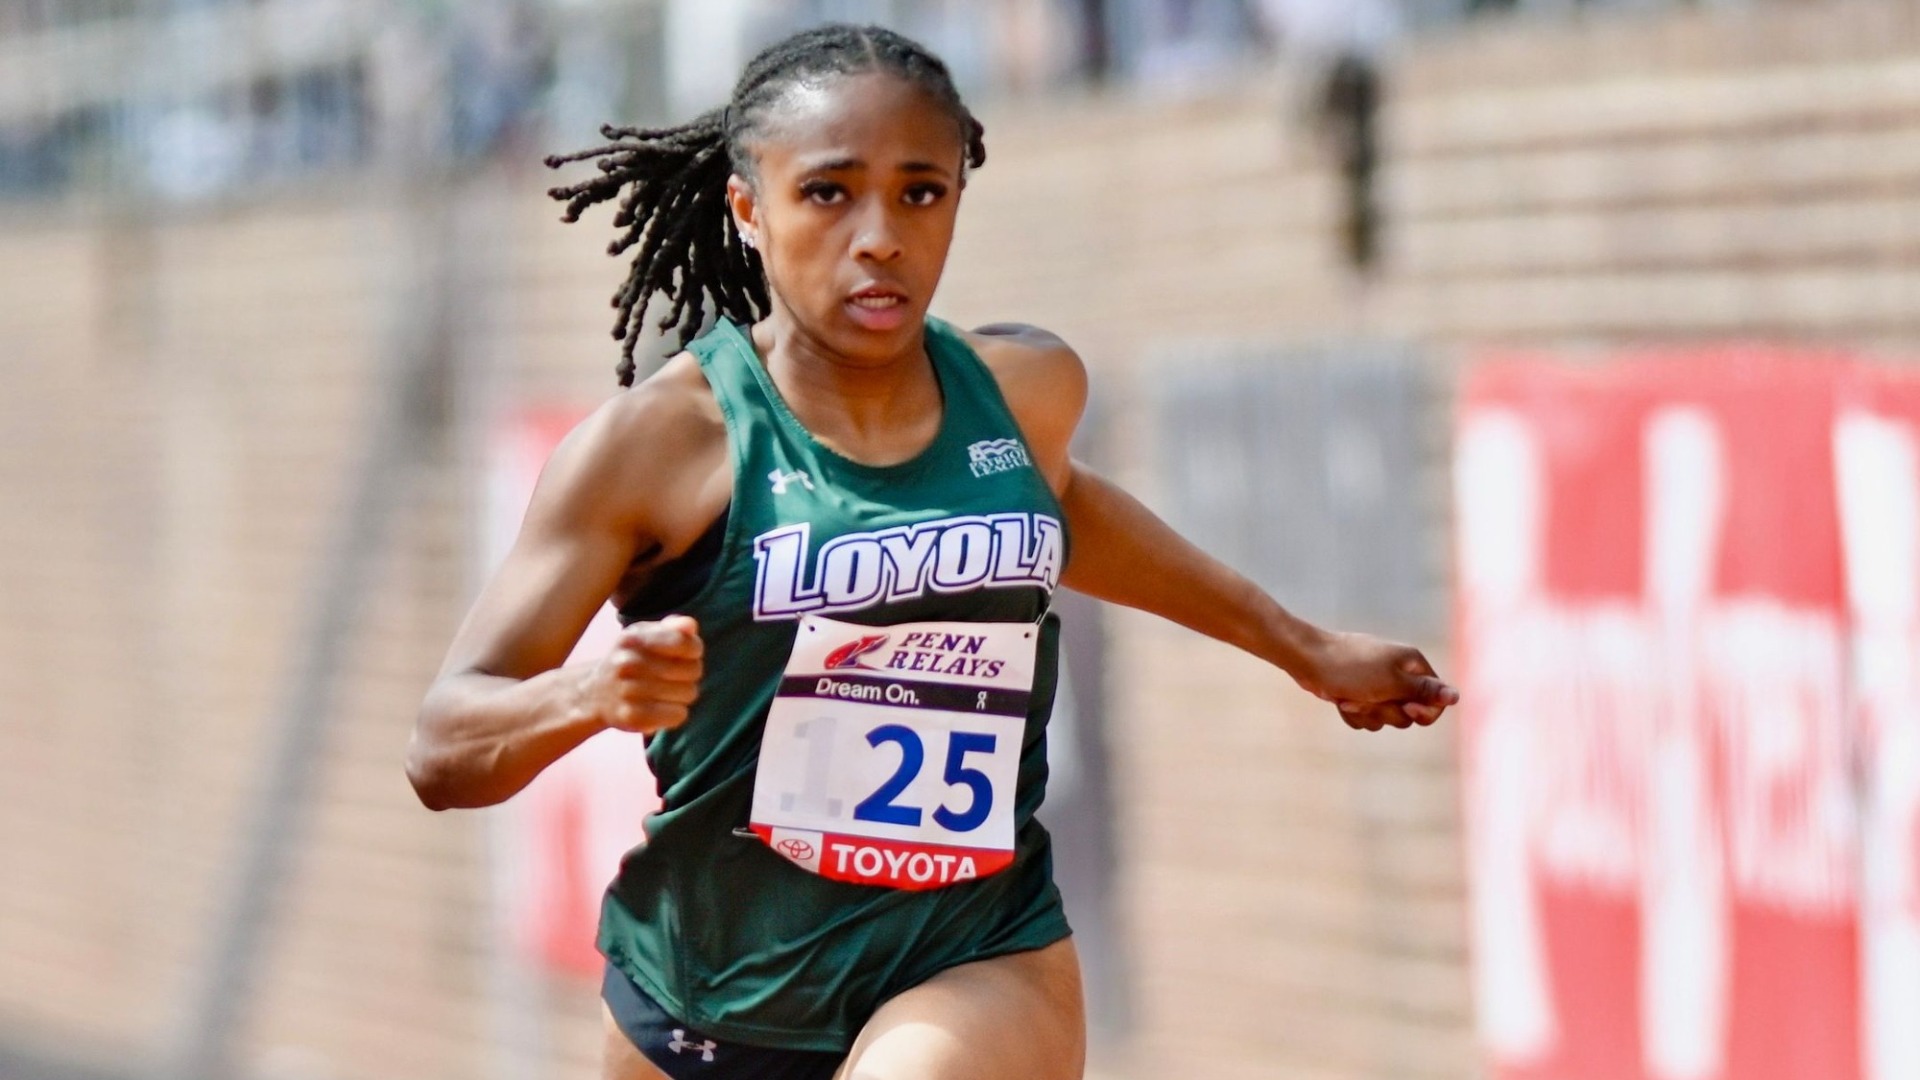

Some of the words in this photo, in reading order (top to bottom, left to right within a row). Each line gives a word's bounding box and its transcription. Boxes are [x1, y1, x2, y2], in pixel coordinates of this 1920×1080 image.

[753, 512, 1063, 622] LOYOLA
[898, 632, 987, 655] PENN
[885, 650, 1006, 679] RELAYS
[815, 677, 882, 701] Dream
[885, 683, 920, 705] On.
[831, 843, 977, 884] TOYOTA
